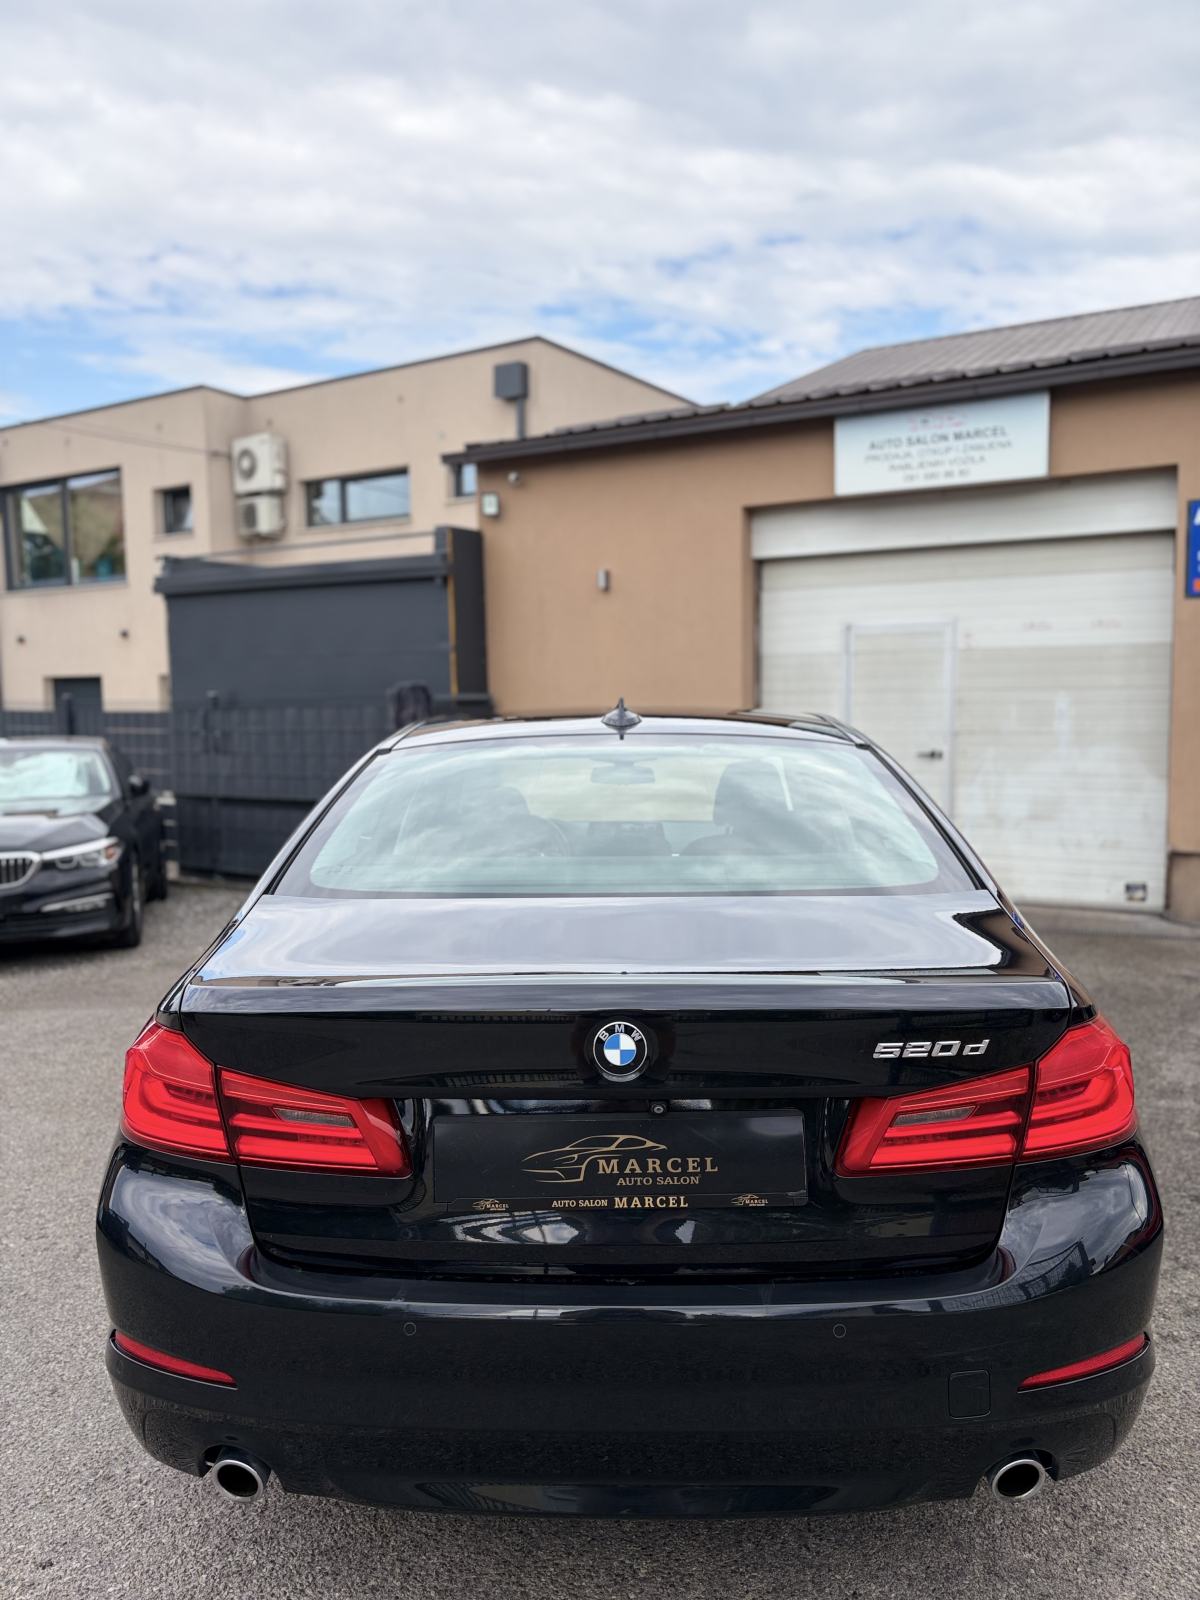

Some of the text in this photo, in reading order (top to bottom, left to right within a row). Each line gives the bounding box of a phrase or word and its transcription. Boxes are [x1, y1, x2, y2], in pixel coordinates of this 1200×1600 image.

[868, 426, 1008, 451] AUTO SALON MARCEL
[599, 1024, 642, 1041] BMW
[872, 1039, 991, 1059] 520d
[597, 1157, 719, 1174] MARCEL
[616, 1176, 700, 1186] AUTO SALON
[551, 1196, 689, 1208] AUTO SALON MARCEL
